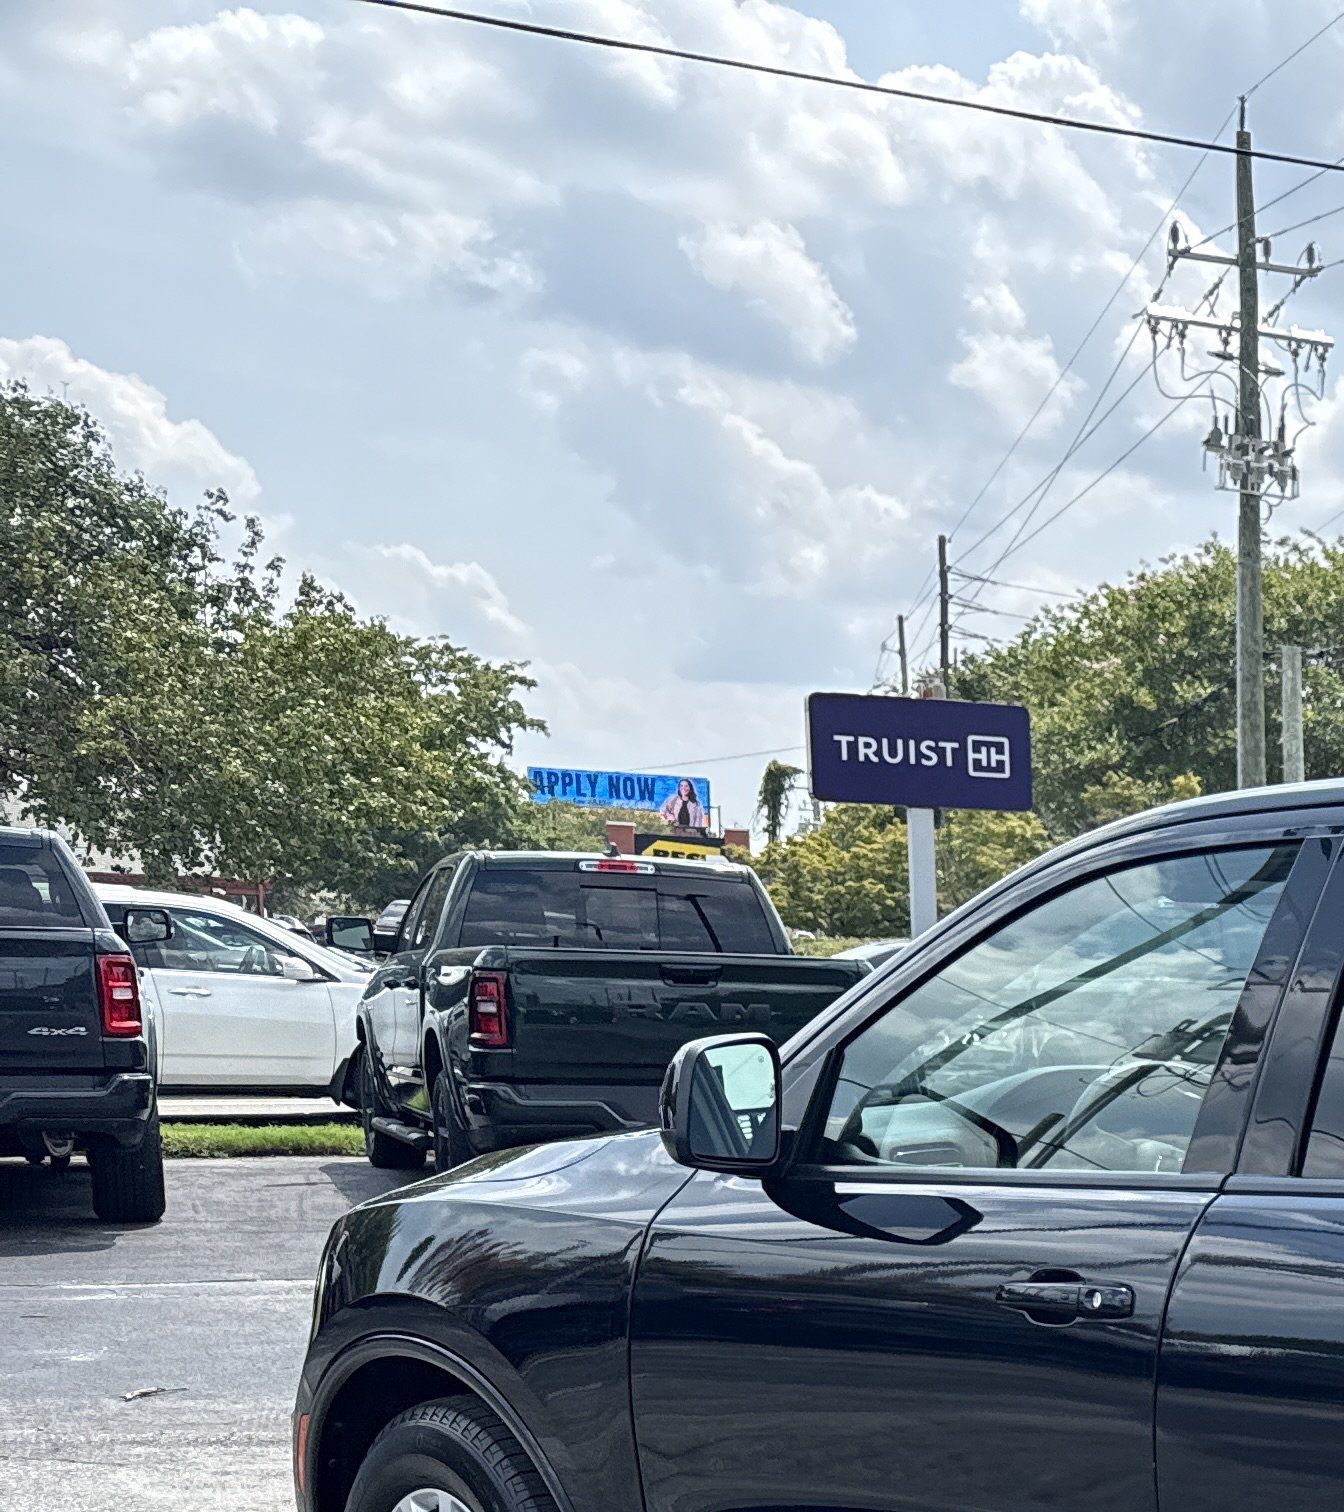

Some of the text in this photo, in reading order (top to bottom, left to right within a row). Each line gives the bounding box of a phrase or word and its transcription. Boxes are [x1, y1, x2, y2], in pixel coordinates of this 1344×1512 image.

[832, 734, 960, 768] TRUIST
[532, 770, 657, 802] APPLY NOW
[612, 1001, 771, 1022] RAM
[27, 1026, 89, 1036] 4x4
